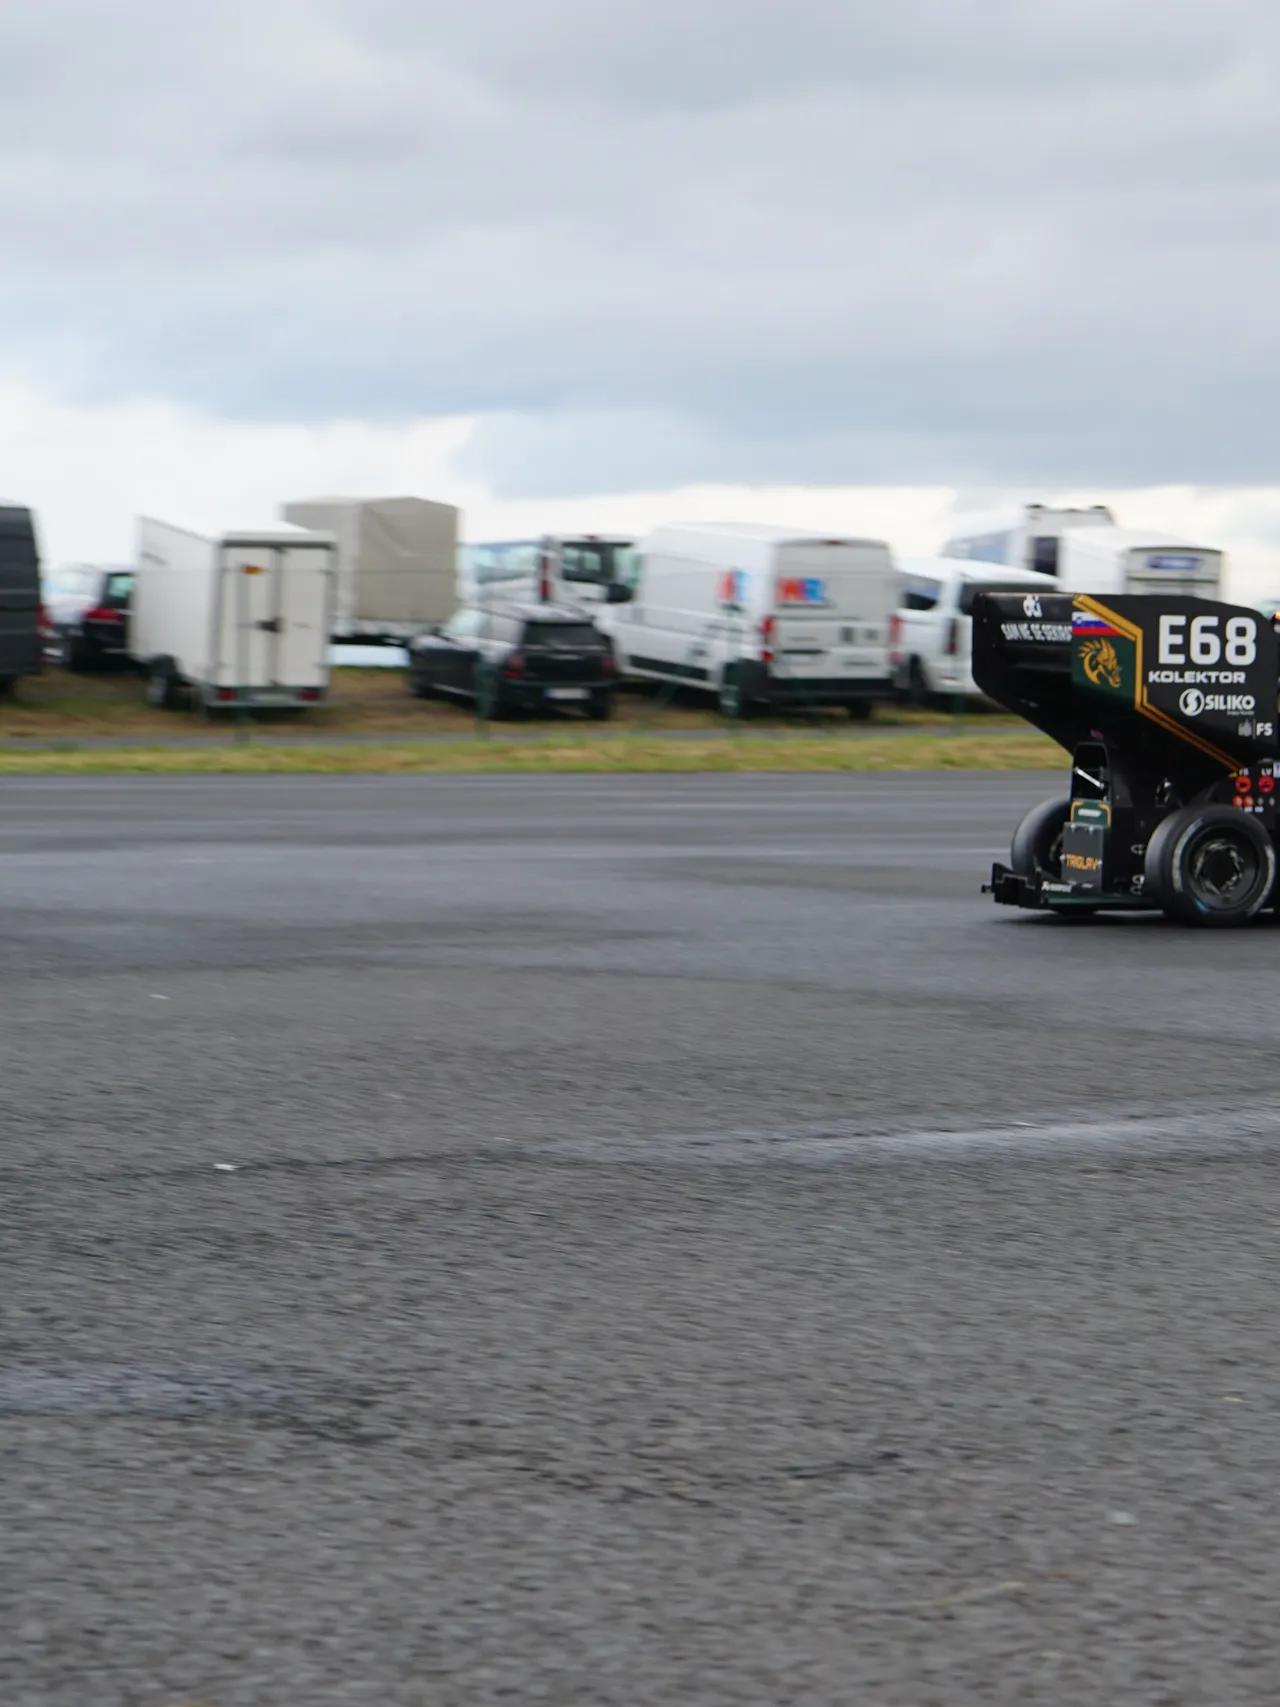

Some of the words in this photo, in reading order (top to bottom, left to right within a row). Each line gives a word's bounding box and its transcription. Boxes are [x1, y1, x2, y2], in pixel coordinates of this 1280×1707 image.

[1158, 614, 1257, 666] E68
[1148, 670, 1247, 684] KOLEKTOR
[1204, 694, 1256, 711] SILIKO
[1256, 722, 1273, 737] FS
